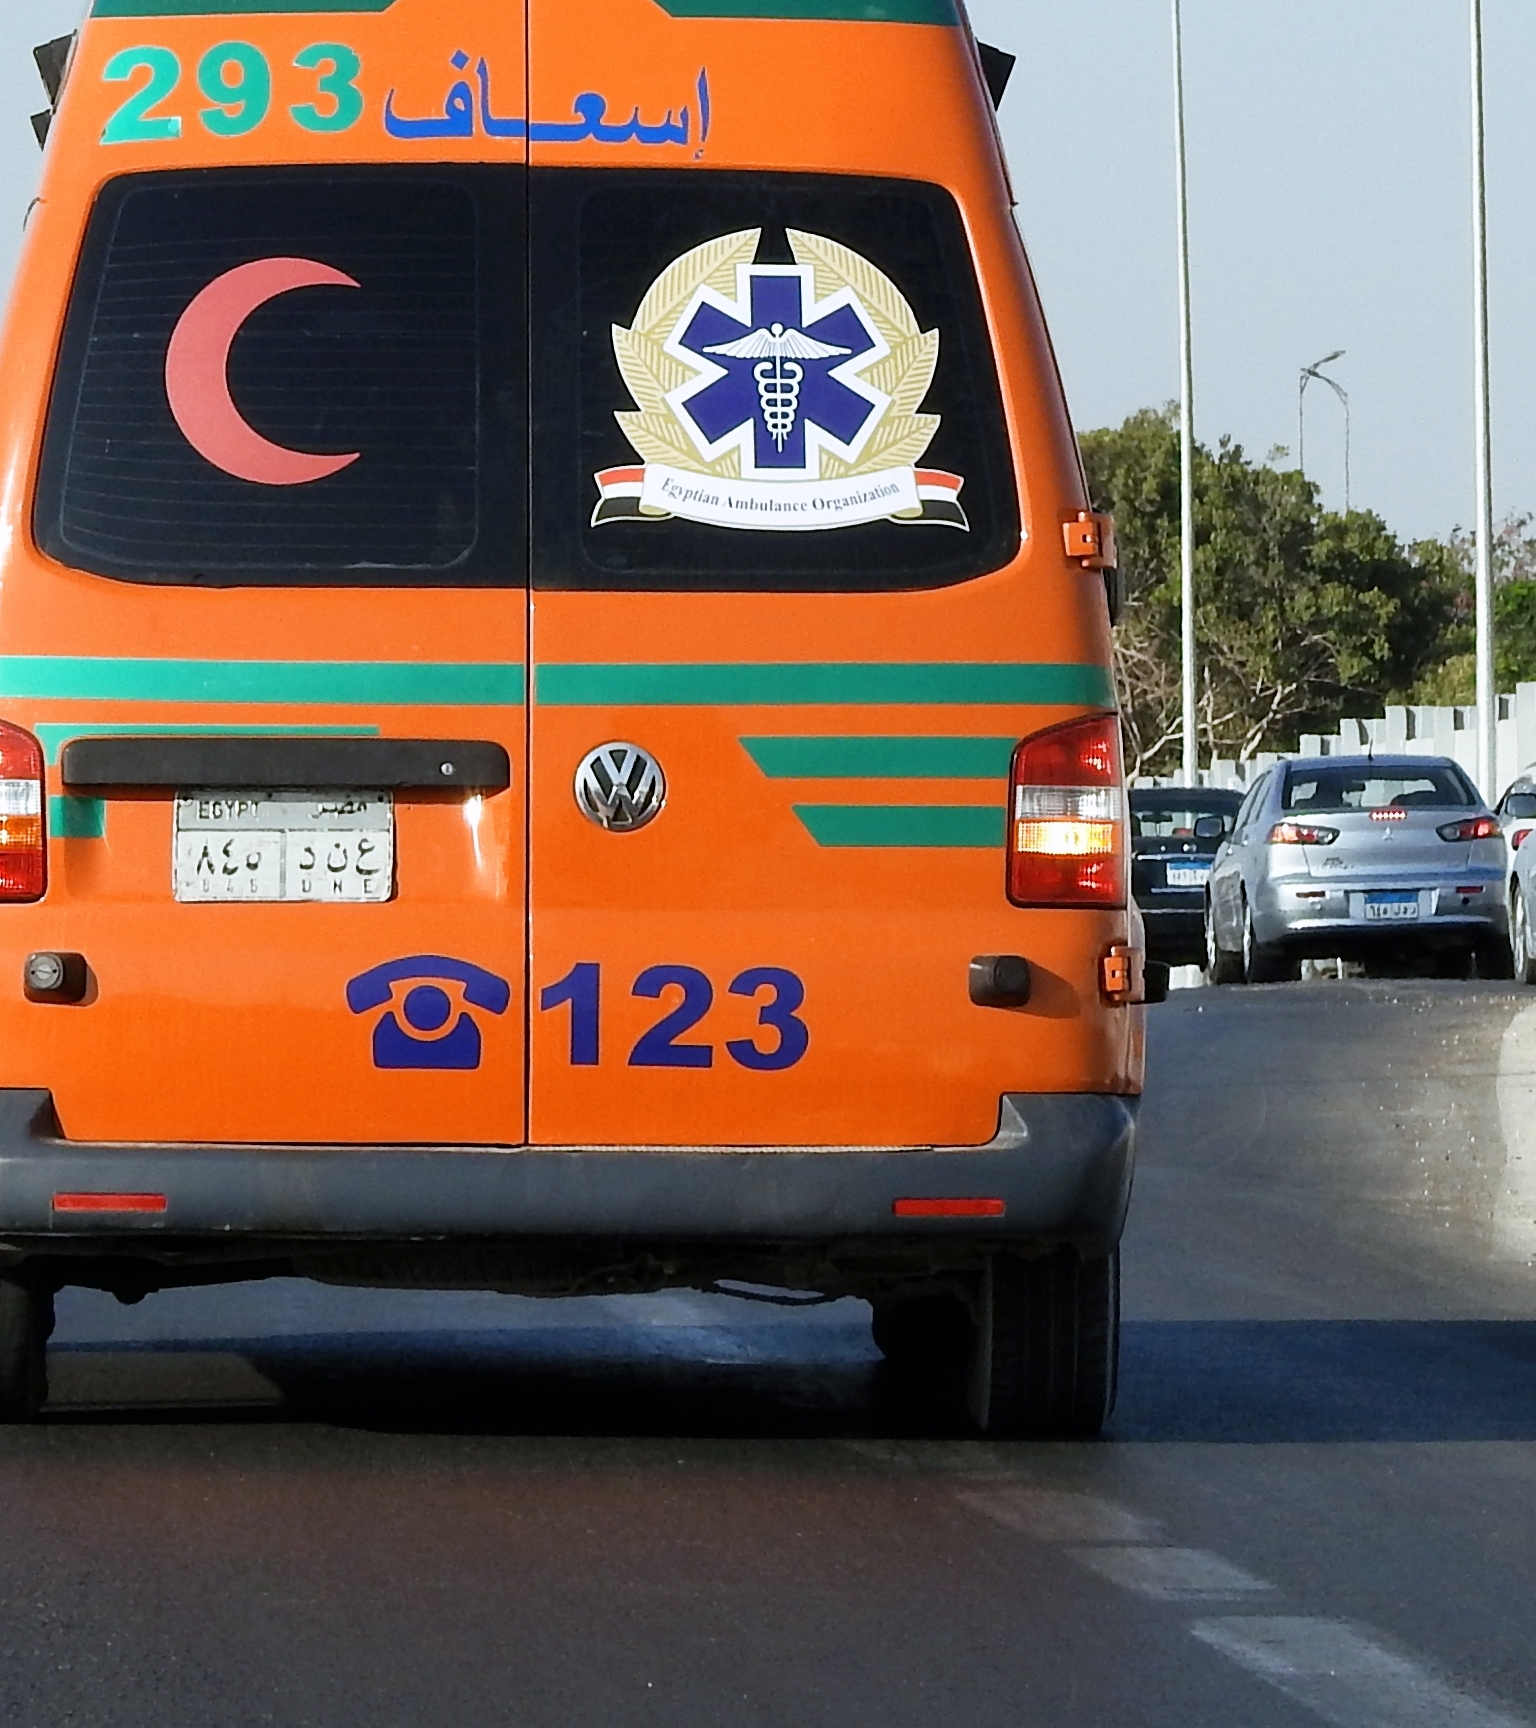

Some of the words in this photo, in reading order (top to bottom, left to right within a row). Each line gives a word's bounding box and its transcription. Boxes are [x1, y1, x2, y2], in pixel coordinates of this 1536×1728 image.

[100, 41, 363, 145] 293
[384, 49, 710, 160] إسعاف
[660, 477, 720, 506] Egyptian
[722, 496, 808, 513] Ambulance
[812, 481, 901, 512] Organization
[199, 800, 259, 819] EGYPT
[196, 838, 262, 875] ٨٤٥
[541, 962, 809, 1071] 123
